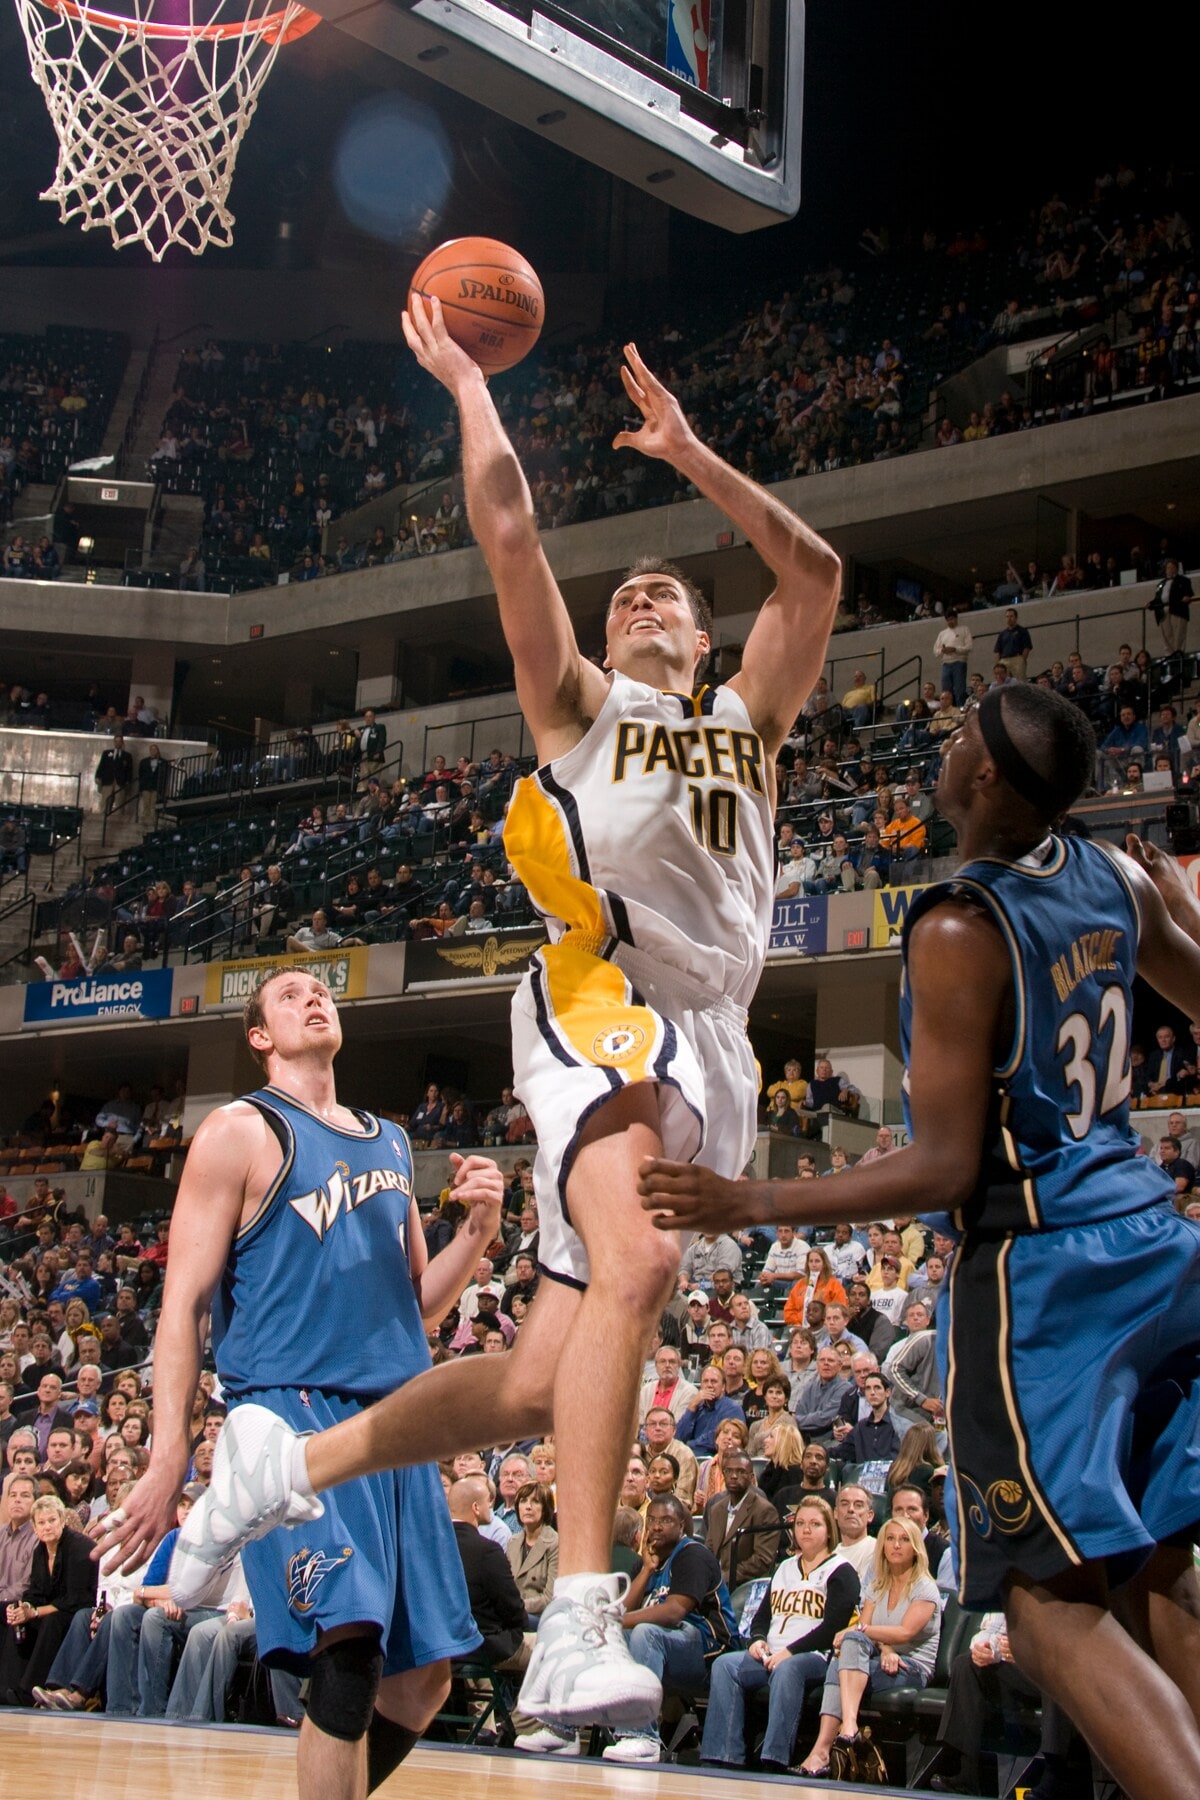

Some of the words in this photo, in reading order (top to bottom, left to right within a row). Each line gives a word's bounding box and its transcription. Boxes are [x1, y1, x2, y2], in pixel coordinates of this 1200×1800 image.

[458, 278, 538, 319] SPALDING
[480, 331, 504, 350] NBA
[612, 721, 765, 797] PACER
[688, 783, 738, 857] 10
[500, 946, 530, 956] SPEEDWAY
[772, 934, 806, 948] LAW
[847, 930, 865, 946] EXIT
[1050, 929, 1123, 1003] BLATCHE
[51, 981, 143, 1007] ProLiance
[1057, 985, 1132, 1140] 32
[85, 1176, 96, 1198] 14
[771, 1589, 824, 1619] PACERS
